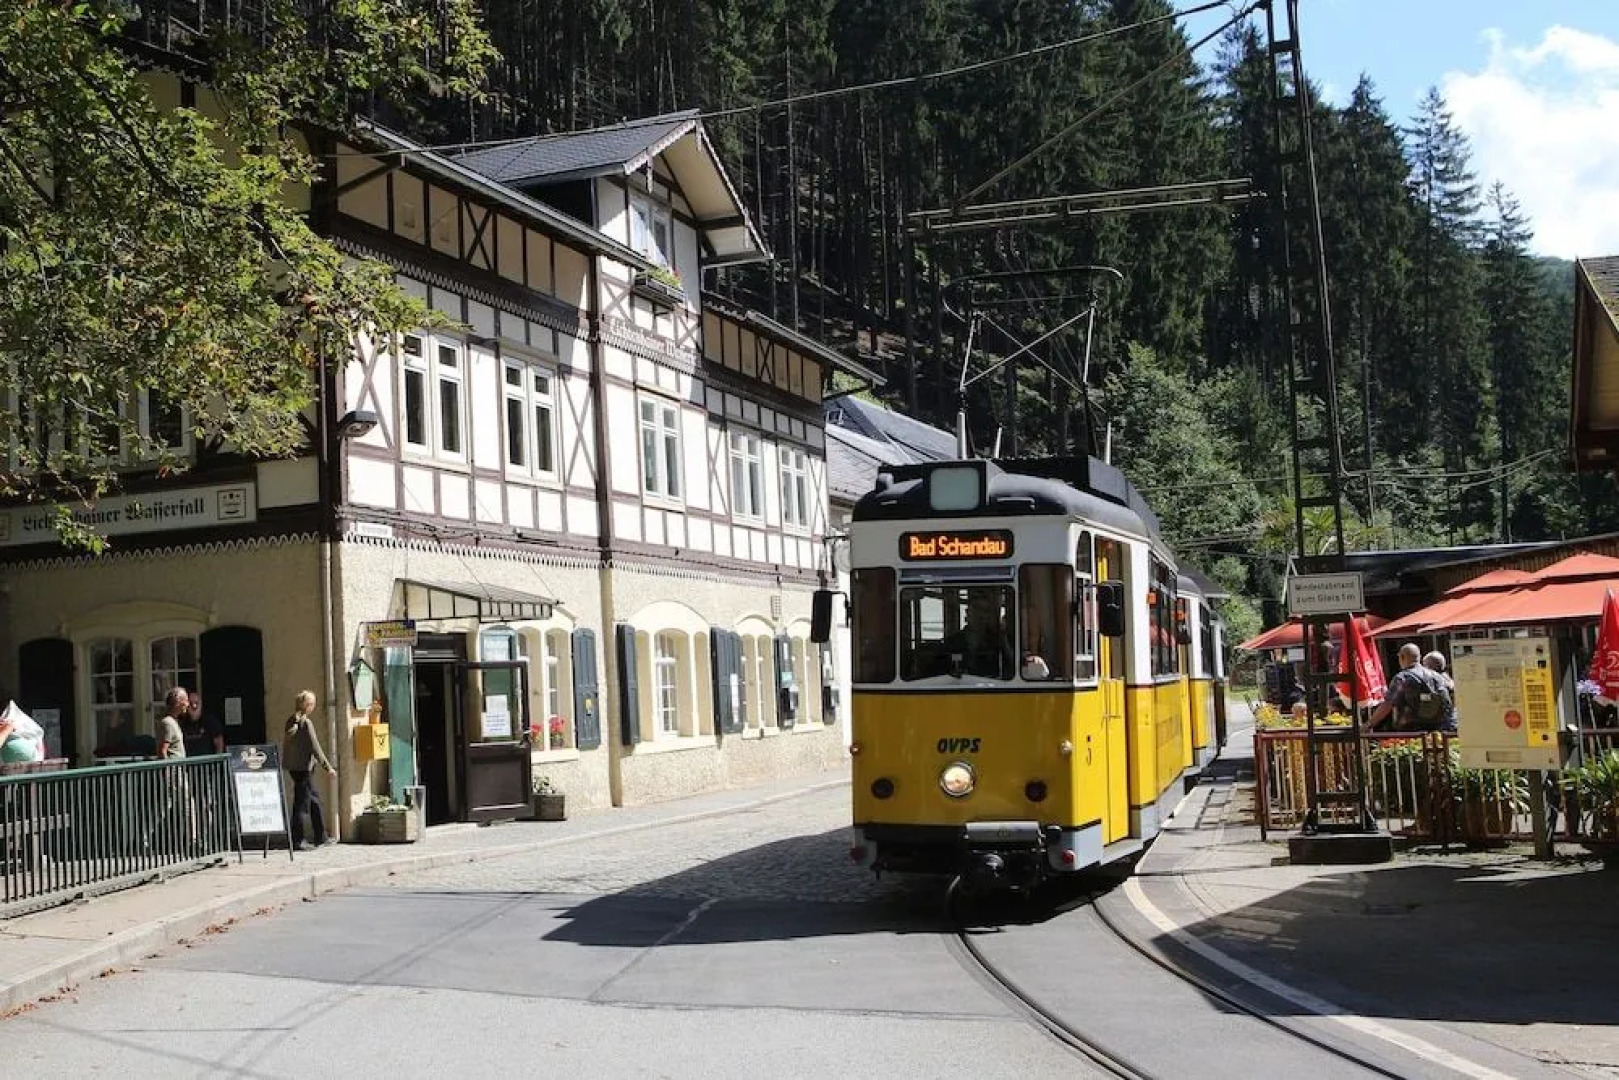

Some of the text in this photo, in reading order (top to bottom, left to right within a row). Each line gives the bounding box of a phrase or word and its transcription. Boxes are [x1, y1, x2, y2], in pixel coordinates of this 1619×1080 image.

[909, 535, 1005, 556] Bad Schandau
[1317, 593, 1340, 602] Gleis
[937, 737, 982, 754] OVPS
